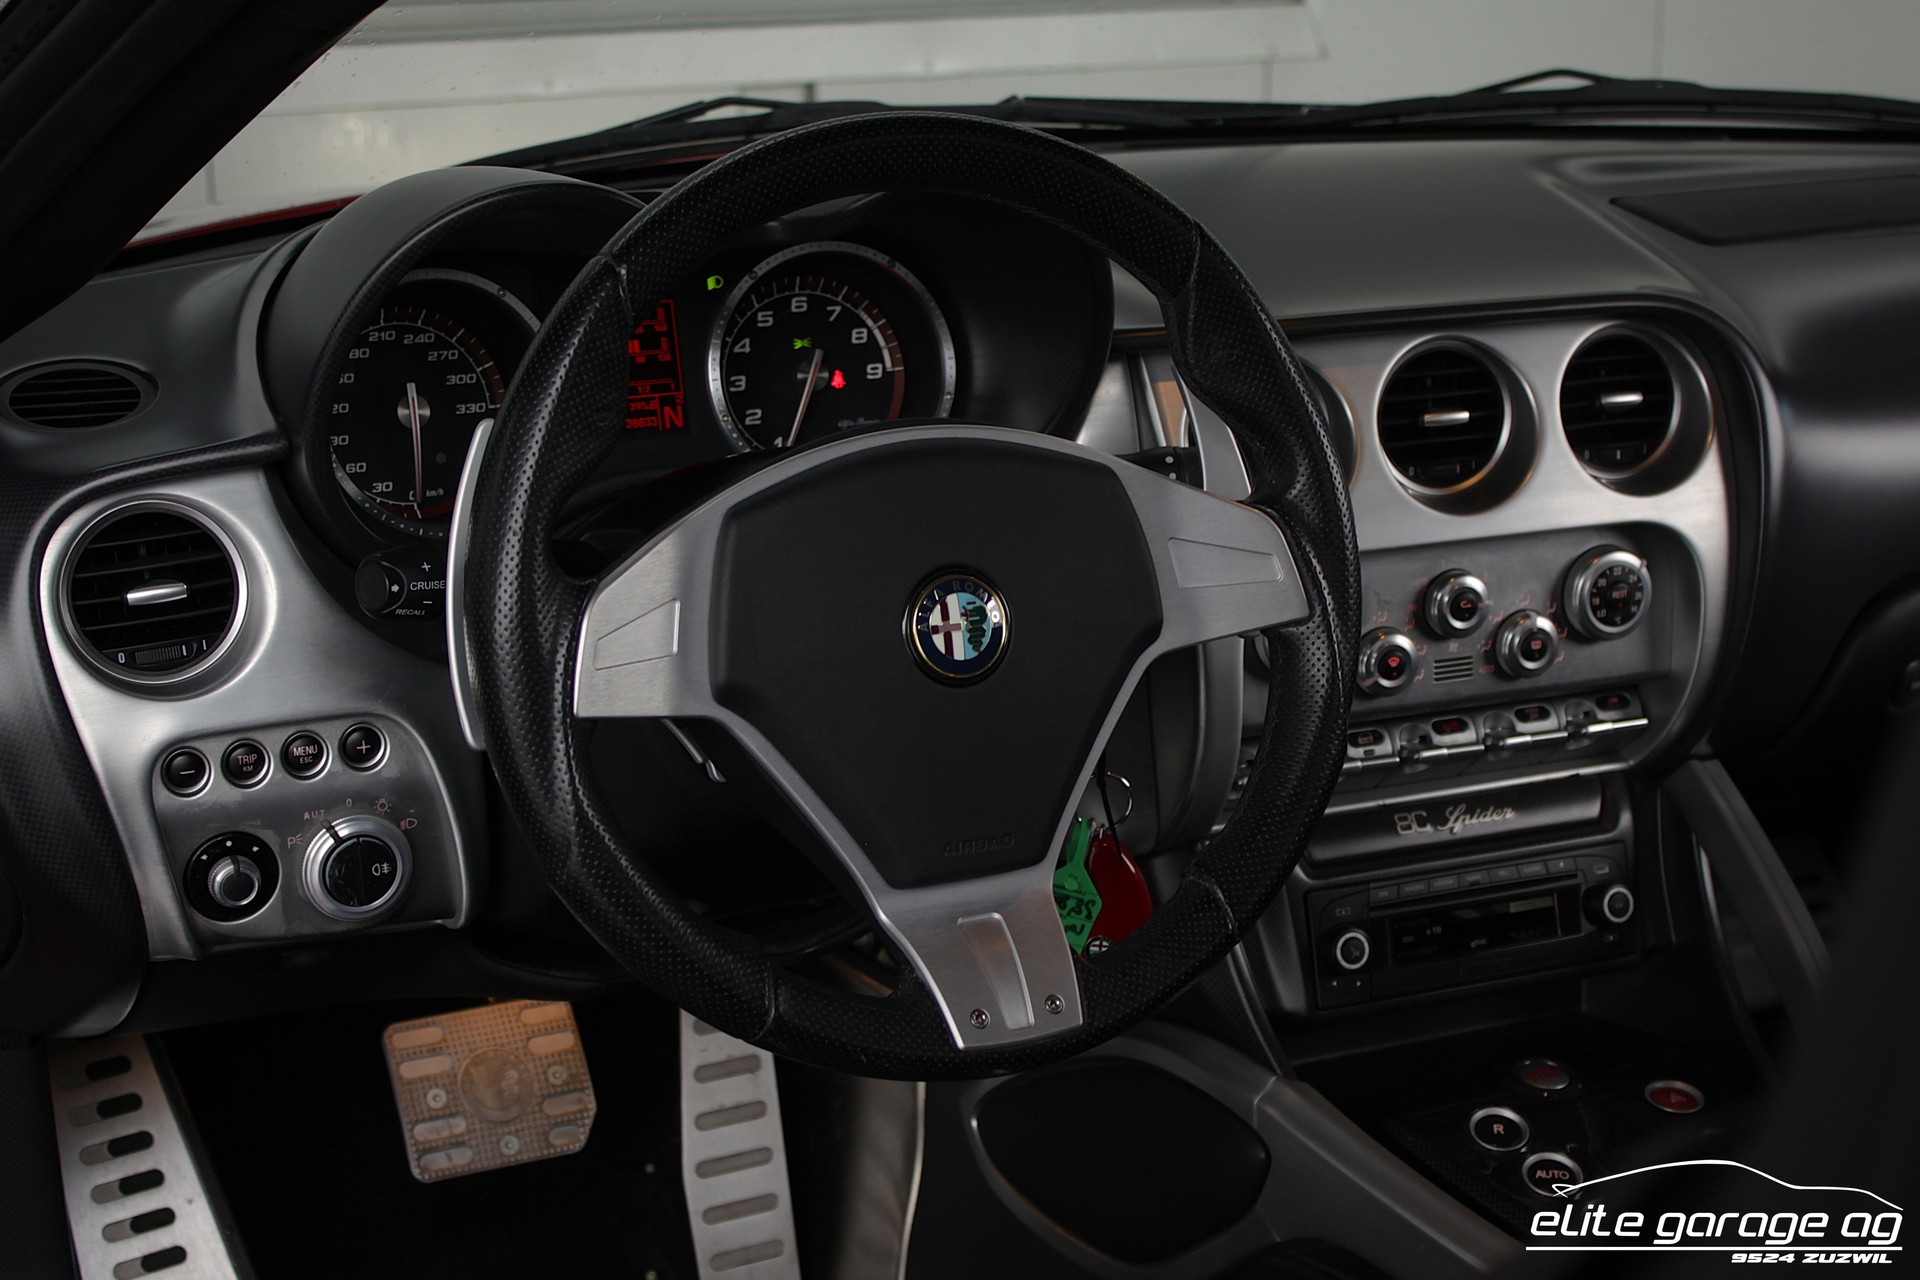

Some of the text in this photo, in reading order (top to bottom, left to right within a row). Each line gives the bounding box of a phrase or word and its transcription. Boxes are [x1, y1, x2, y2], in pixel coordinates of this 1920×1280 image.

[791, 296, 808, 313] 6
[756, 310, 774, 327] 5
[826, 305, 842, 322] 7
[368, 330, 396, 342] 210
[403, 332, 435, 344] 240
[851, 328, 868, 344] 8
[733, 337, 751, 354] 4
[348, 348, 370, 359] 80
[427, 349, 459, 361] 270
[866, 363, 883, 379] 9
[446, 373, 477, 385] 300
[729, 375, 746, 392] 3
[332, 403, 350, 414] 20
[455, 403, 486, 414] 330
[664, 405, 684, 429] N
[745, 408, 762, 425] 2
[345, 462, 367, 474] 60
[372, 482, 393, 493] 30
[410, 580, 446, 591] CRUISE
[293, 744, 318, 757] MENU
[237, 753, 258, 765] TRIP
[300, 756, 313, 764] ESC
[346, 798, 353, 807] 0
[1394, 803, 1516, 834] 8C Spider
[1493, 1123, 1505, 1135] R
[1535, 1169, 1570, 1181] AUTO
